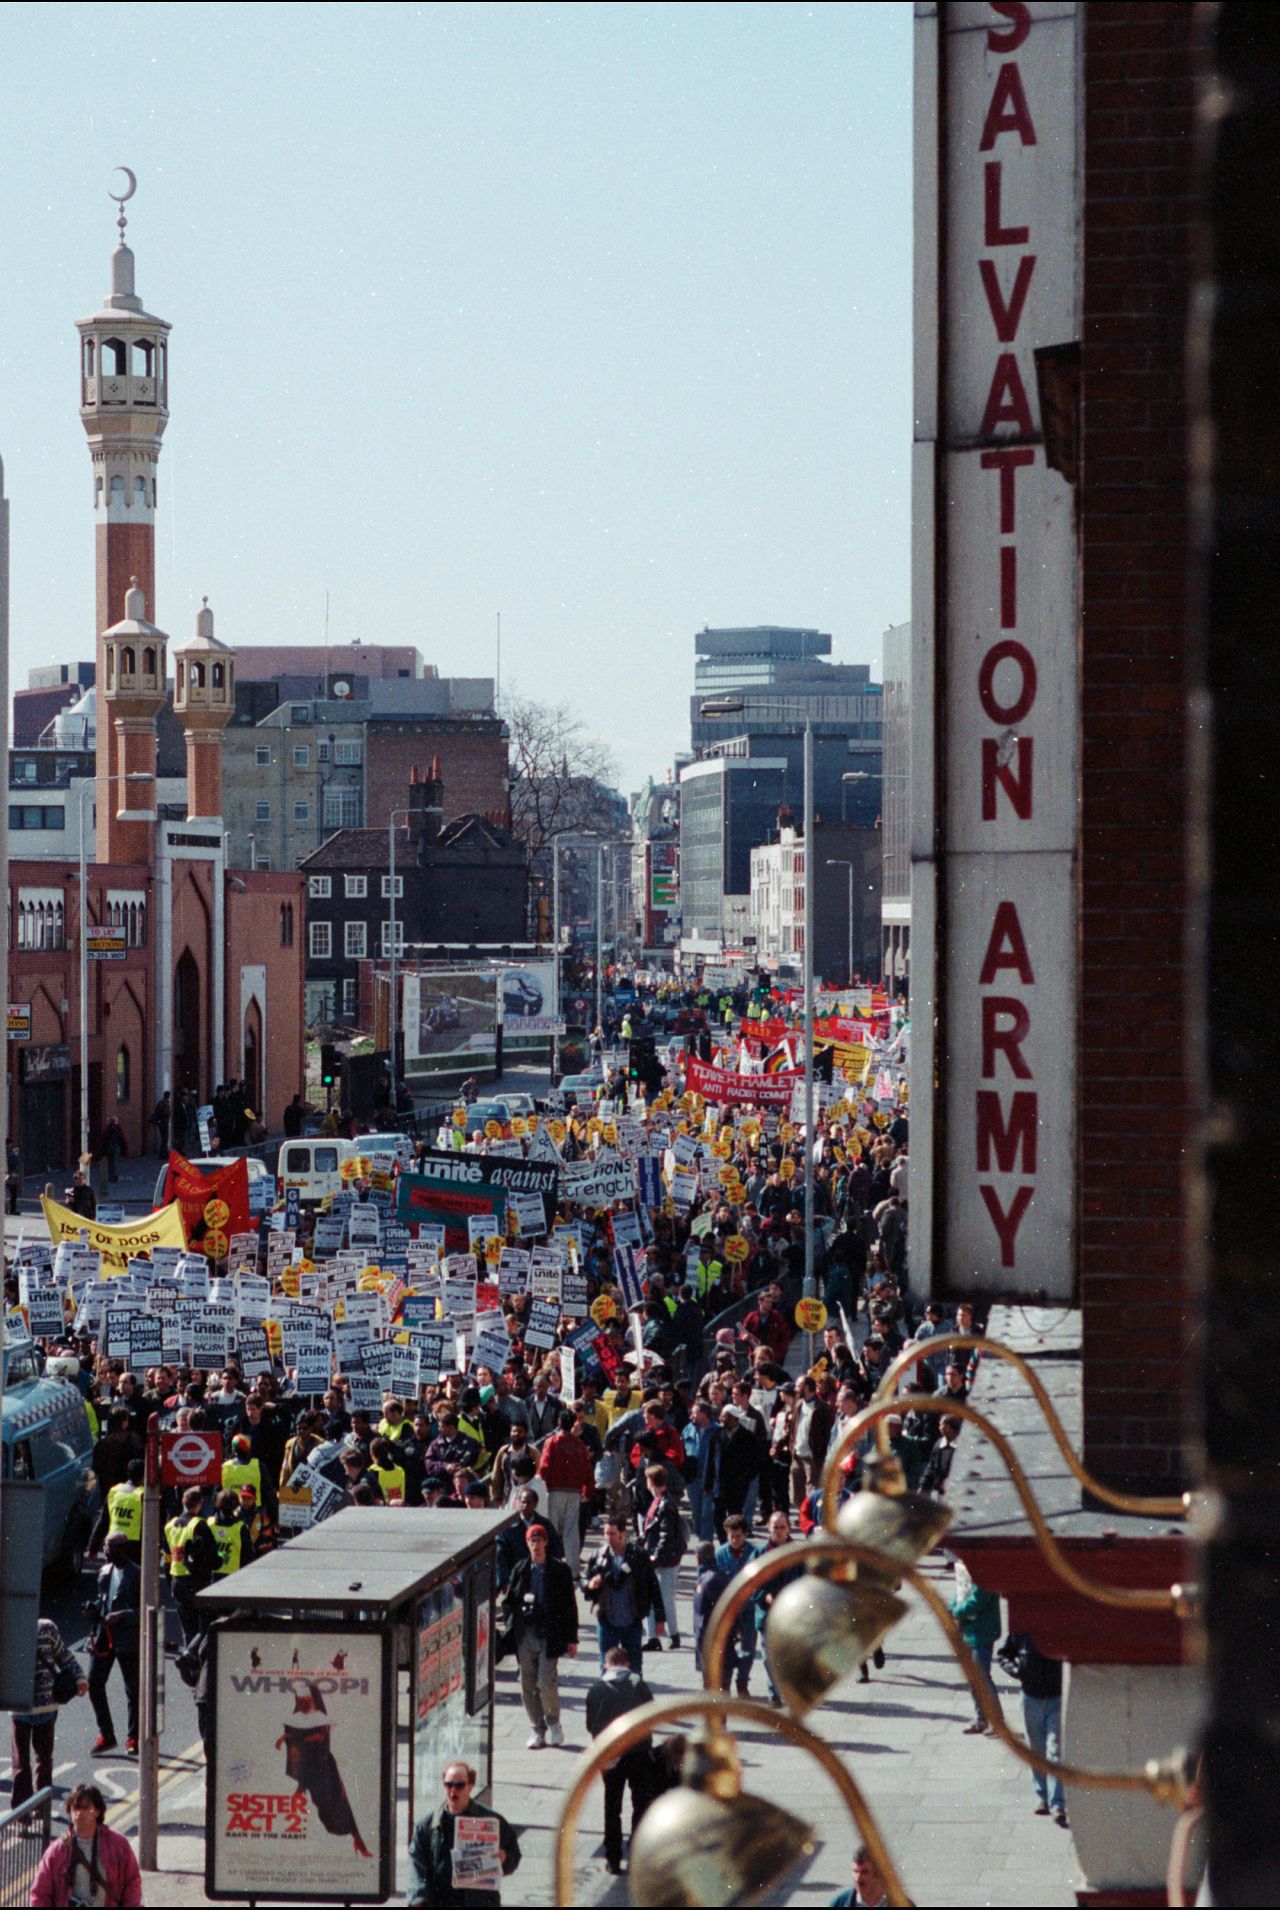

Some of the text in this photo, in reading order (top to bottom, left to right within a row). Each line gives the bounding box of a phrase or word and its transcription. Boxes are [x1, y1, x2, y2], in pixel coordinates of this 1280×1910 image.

[976, 1, 1038, 1268] SALVATION ARMY
[692, 1064, 736, 1086] TOWER
[703, 1083, 722, 1094] ANTI
[490, 1162, 556, 1191] against
[286, 1190, 299, 1226] GMB
[119, 1231, 160, 1246] DOGS
[203, 1304, 235, 1316] unite
[131, 1319, 160, 1331] unite
[193, 1322, 225, 1334] unite
[283, 1320, 313, 1332] unite
[299, 1344, 329, 1357] unite
[351, 1376, 380, 1390] unite
[114, 1507, 135, 1519] TUC
[230, 1675, 370, 1696] WHOOPI
[226, 1791, 308, 1815] SISTER
[226, 1812, 308, 1833] ACT 2:
